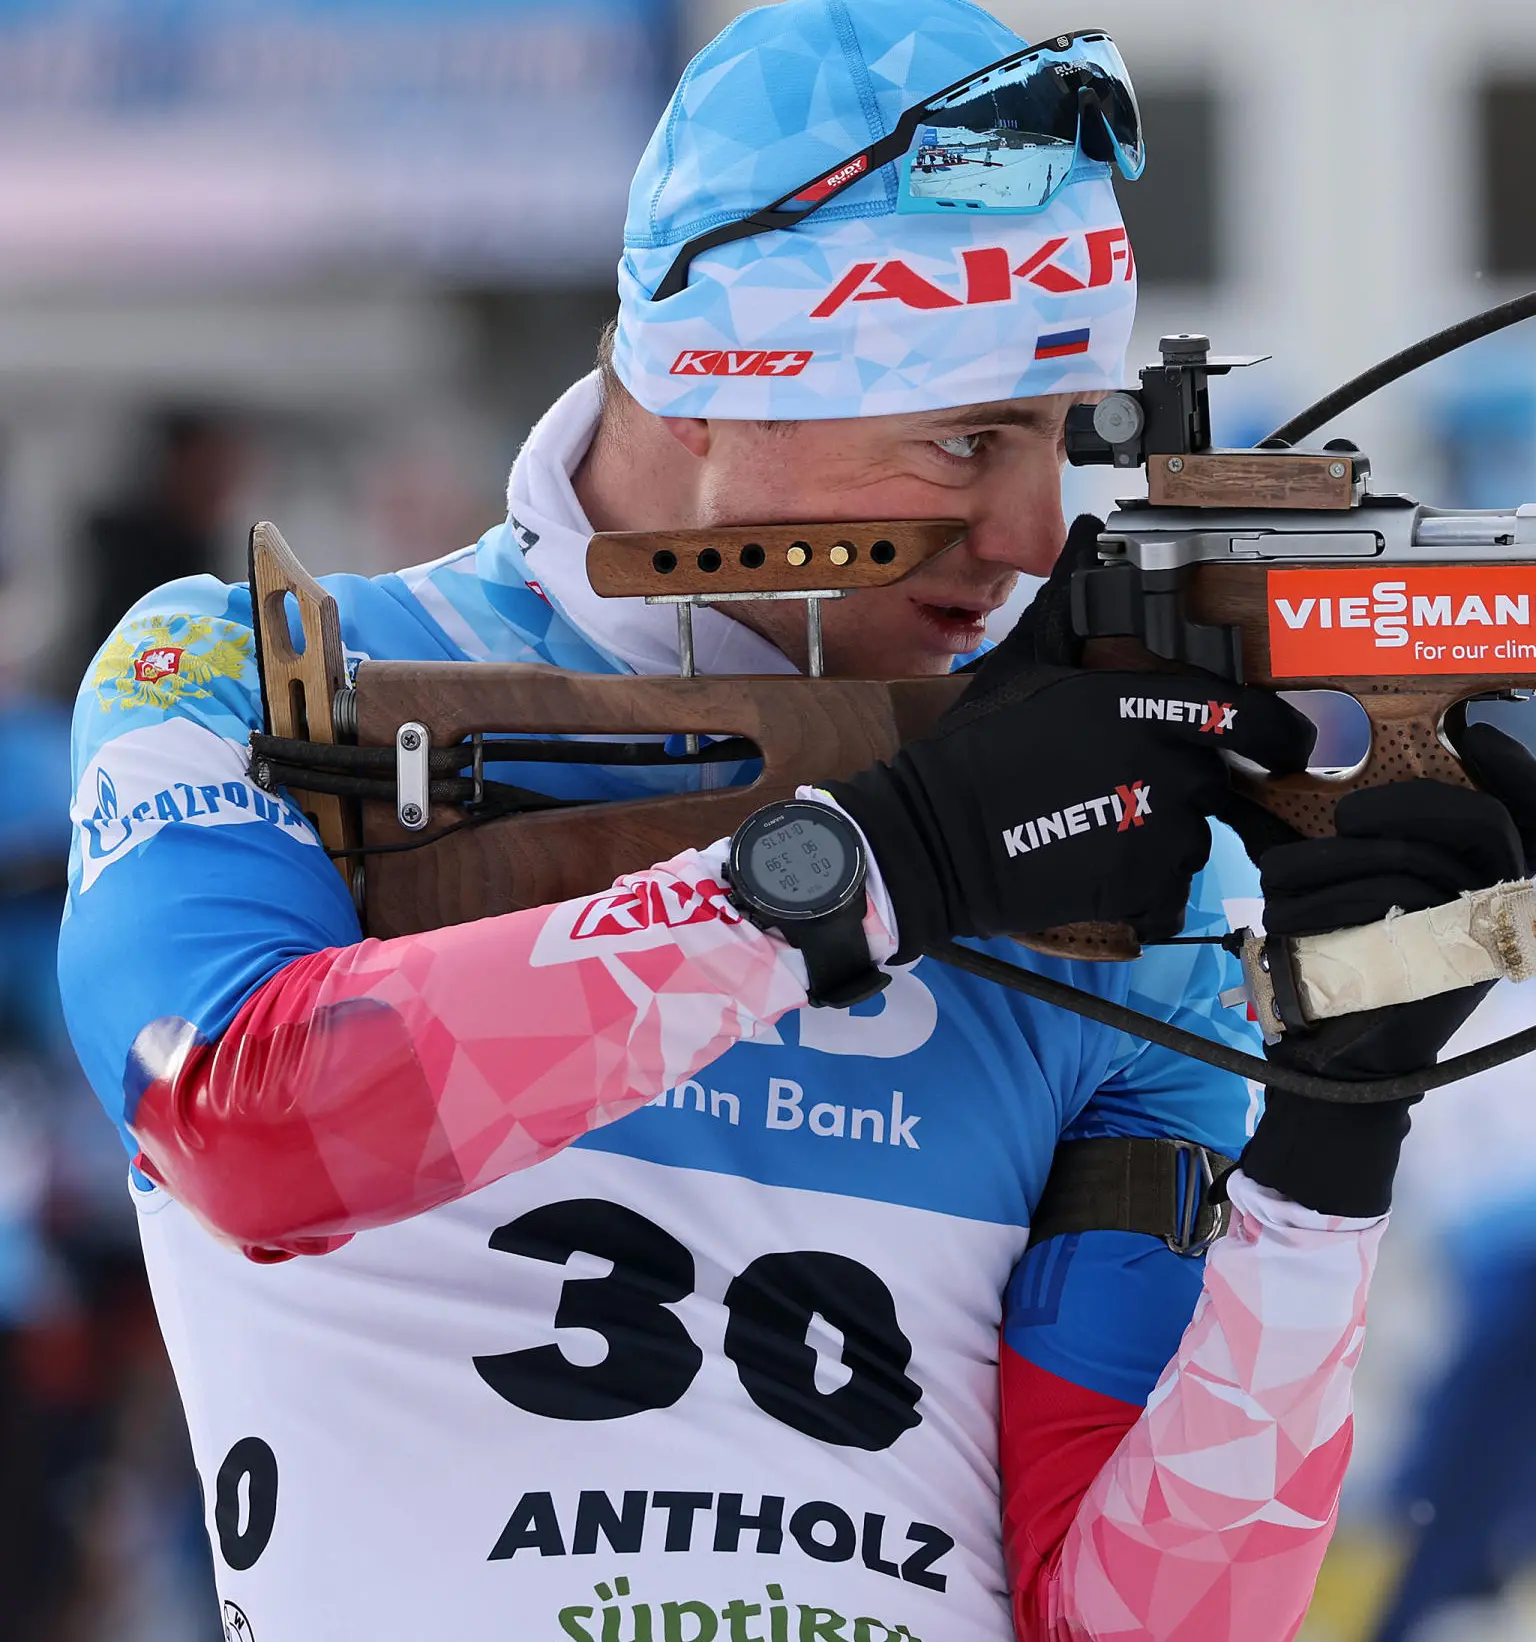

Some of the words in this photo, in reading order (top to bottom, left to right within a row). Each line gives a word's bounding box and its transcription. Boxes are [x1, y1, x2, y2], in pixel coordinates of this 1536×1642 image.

[827, 159, 862, 187] RUDY
[809, 227, 1134, 318] AKF
[1414, 641, 1446, 660] for
[1452, 643, 1489, 660] our
[765, 1076, 922, 1151] Bank
[471, 1197, 924, 1452] 30
[487, 1490, 955, 1594] ANTHOLZ
